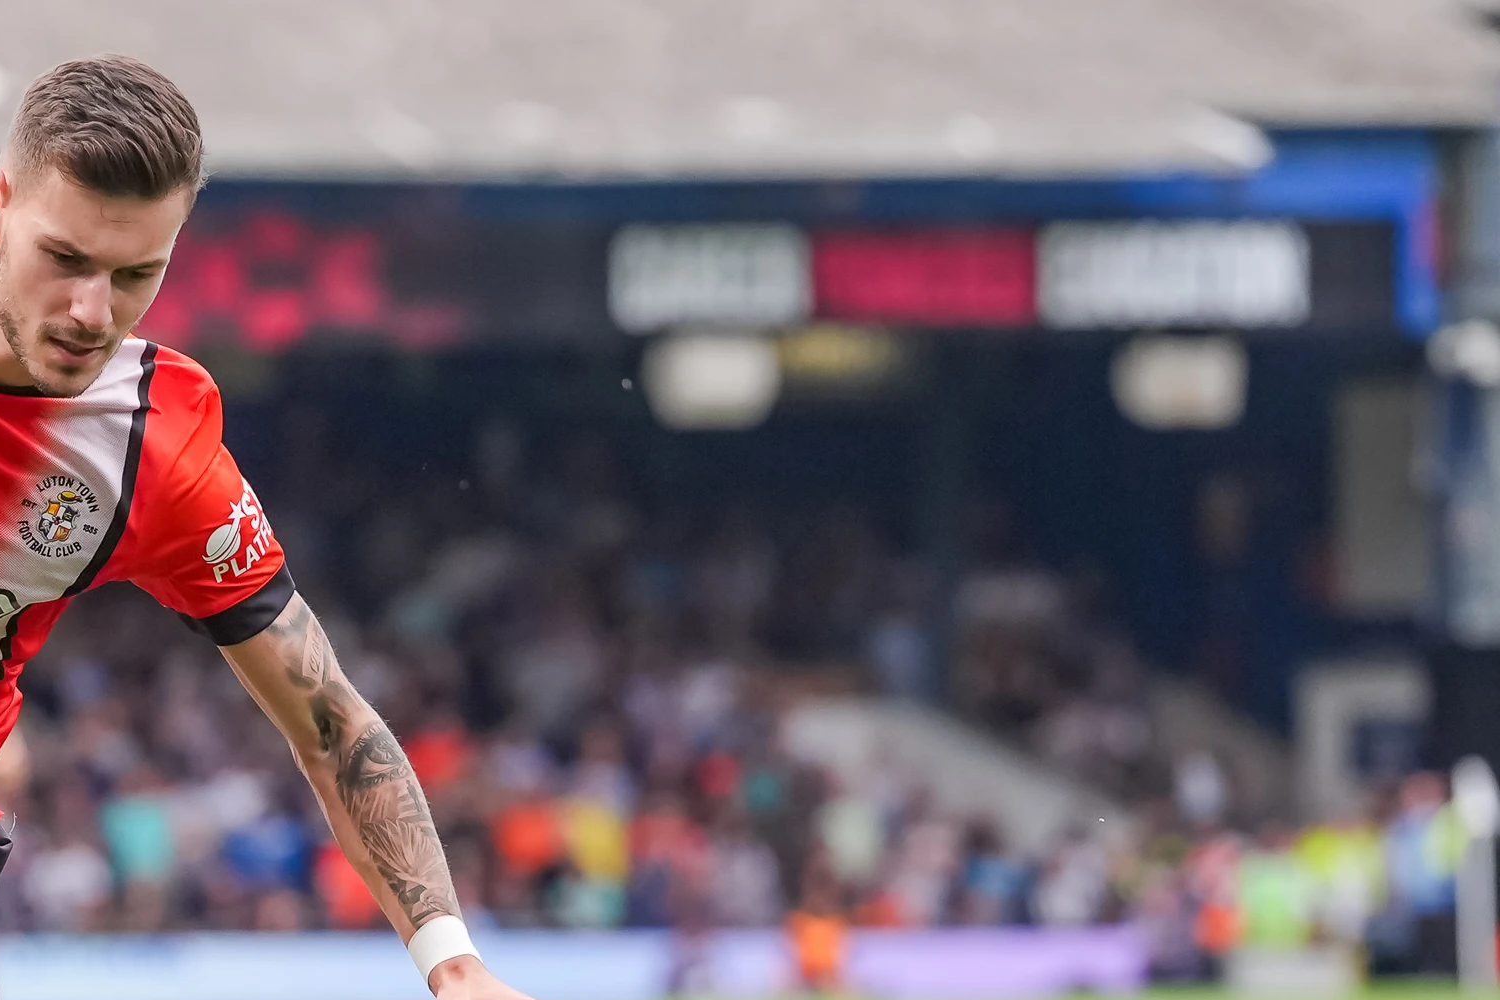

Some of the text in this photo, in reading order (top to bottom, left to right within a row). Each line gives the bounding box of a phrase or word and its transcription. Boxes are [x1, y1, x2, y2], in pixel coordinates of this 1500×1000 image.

[36, 475, 100, 513] LUTON TOWN
[18, 520, 82, 558] FOOTBALL CLUB
